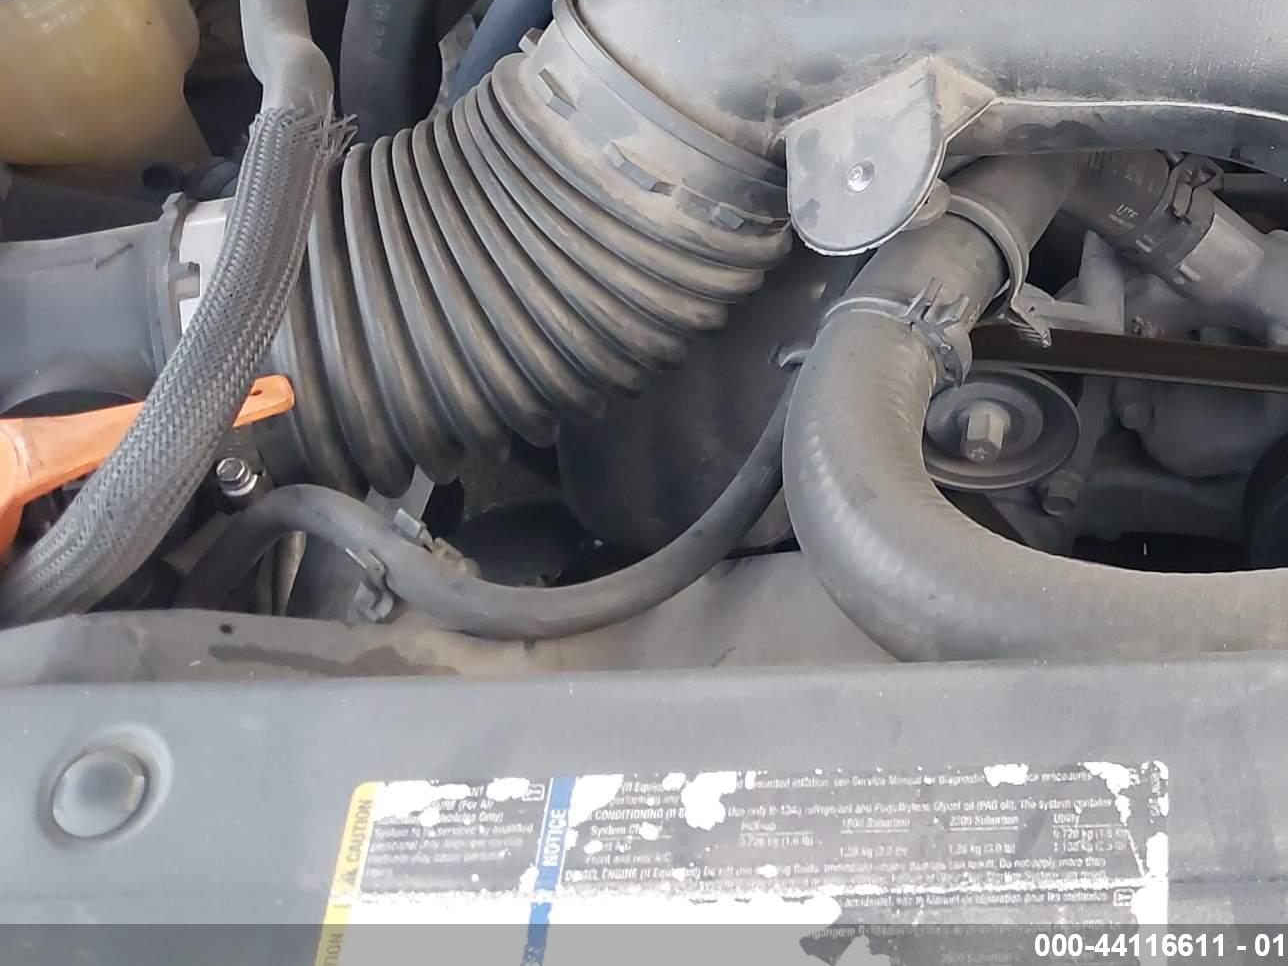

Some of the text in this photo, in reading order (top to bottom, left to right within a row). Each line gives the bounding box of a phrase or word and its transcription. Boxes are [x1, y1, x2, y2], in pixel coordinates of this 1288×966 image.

[1019, 799, 1037, 811] The
[595, 807, 664, 820] CONDITIONING
[345, 798, 374, 863] CAUTION
[542, 809, 567, 867] NOTICE
[999, 858, 1013, 869] Do
